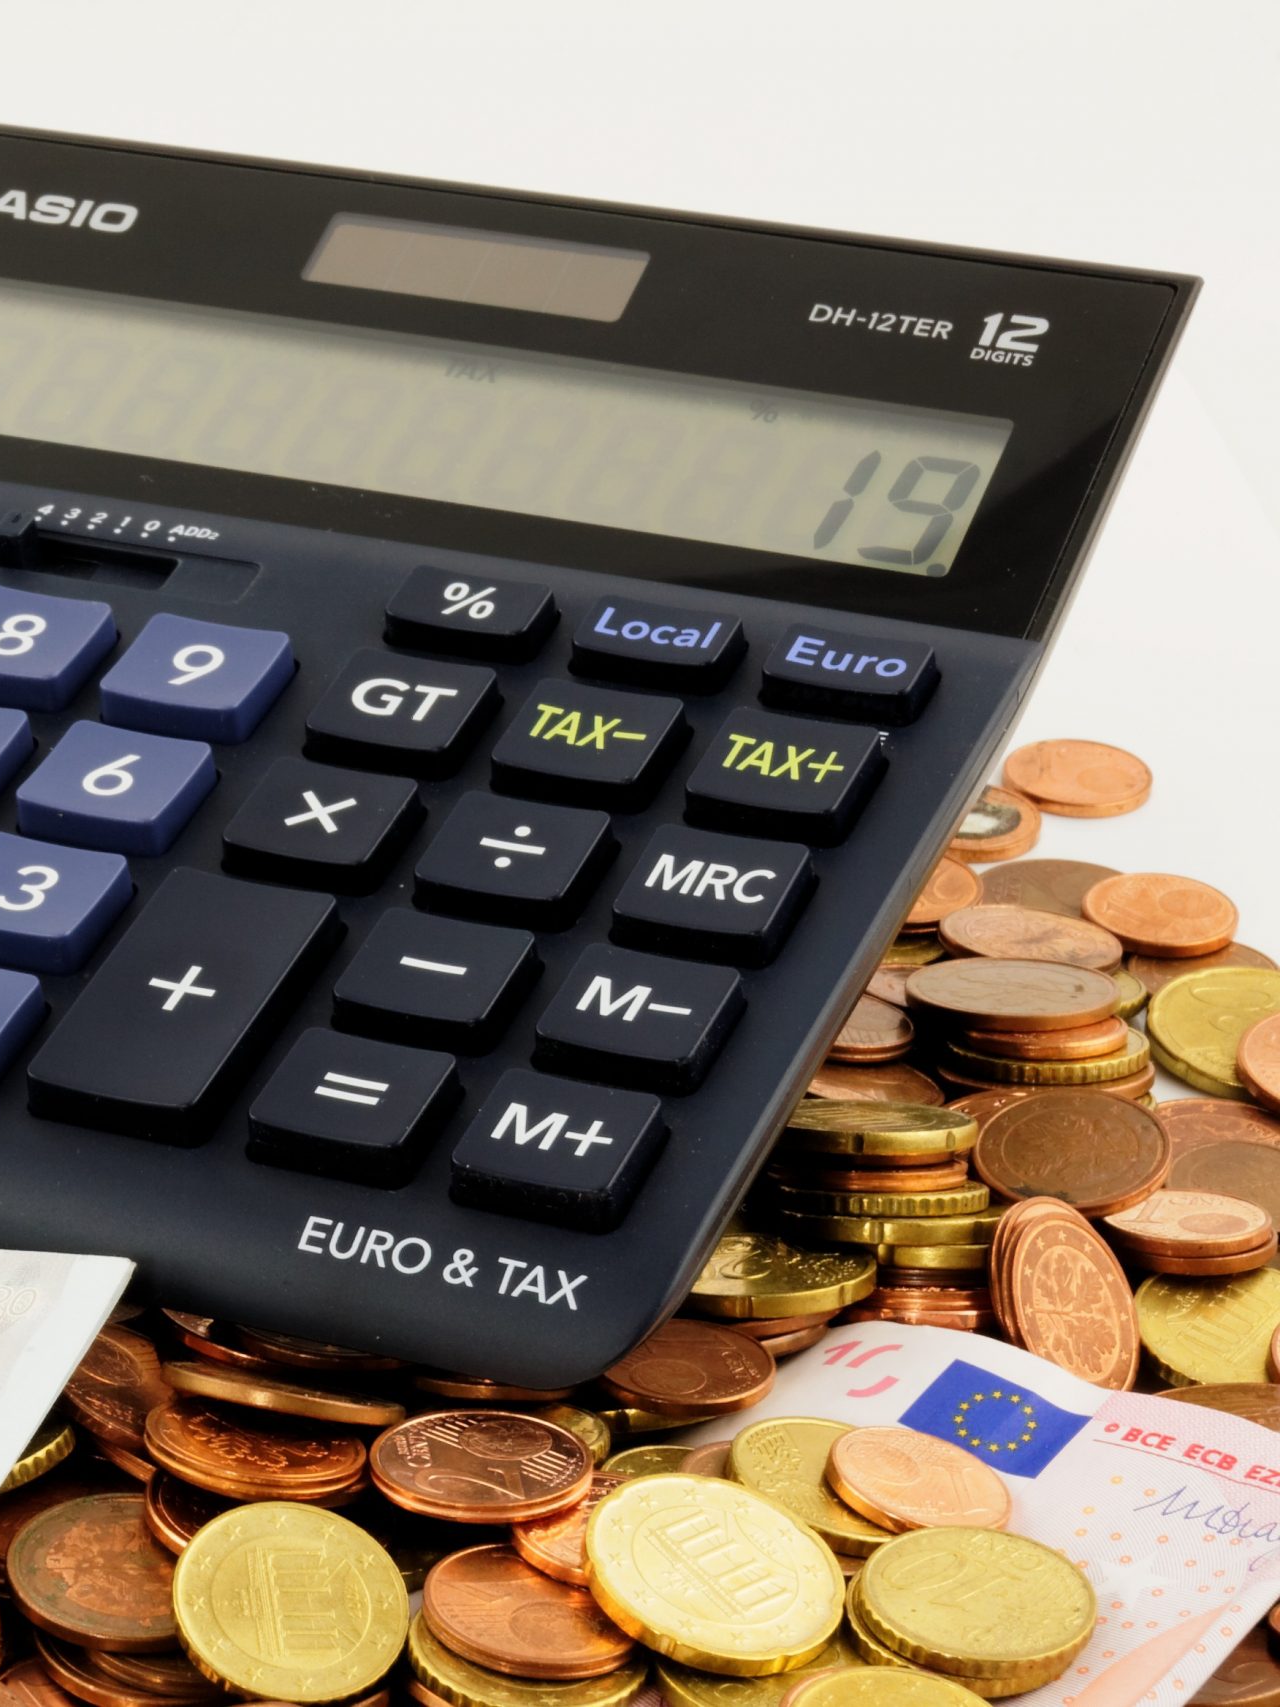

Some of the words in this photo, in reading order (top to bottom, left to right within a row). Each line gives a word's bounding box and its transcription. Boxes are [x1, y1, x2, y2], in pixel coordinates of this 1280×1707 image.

[808, 303, 953, 340] DH-12TER
[976, 308, 1056, 353] 12
[970, 347, 1035, 368] DIGITS
[37, 503, 56, 516] 4
[63, 507, 83, 520] 3
[89, 511, 109, 524] 2
[120, 515, 133, 528] 1
[143, 519, 162, 532] 0
[441, 582, 497, 620] %
[594, 606, 722, 649] Local
[168, 644, 225, 686] 9
[785, 635, 907, 677] Euro
[351, 677, 459, 722] GT
[82, 754, 141, 797] 6
[722, 733, 845, 783] TAX+
[644, 853, 777, 904] MRC
[490, 1102, 613, 1157] M+
[297, 1215, 432, 1275] EURO
[442, 1248, 479, 1288] &
[497, 1256, 588, 1311] TAX
[1121, 1427, 1176, 1451] BCE
[1183, 1443, 1238, 1471] ECB
